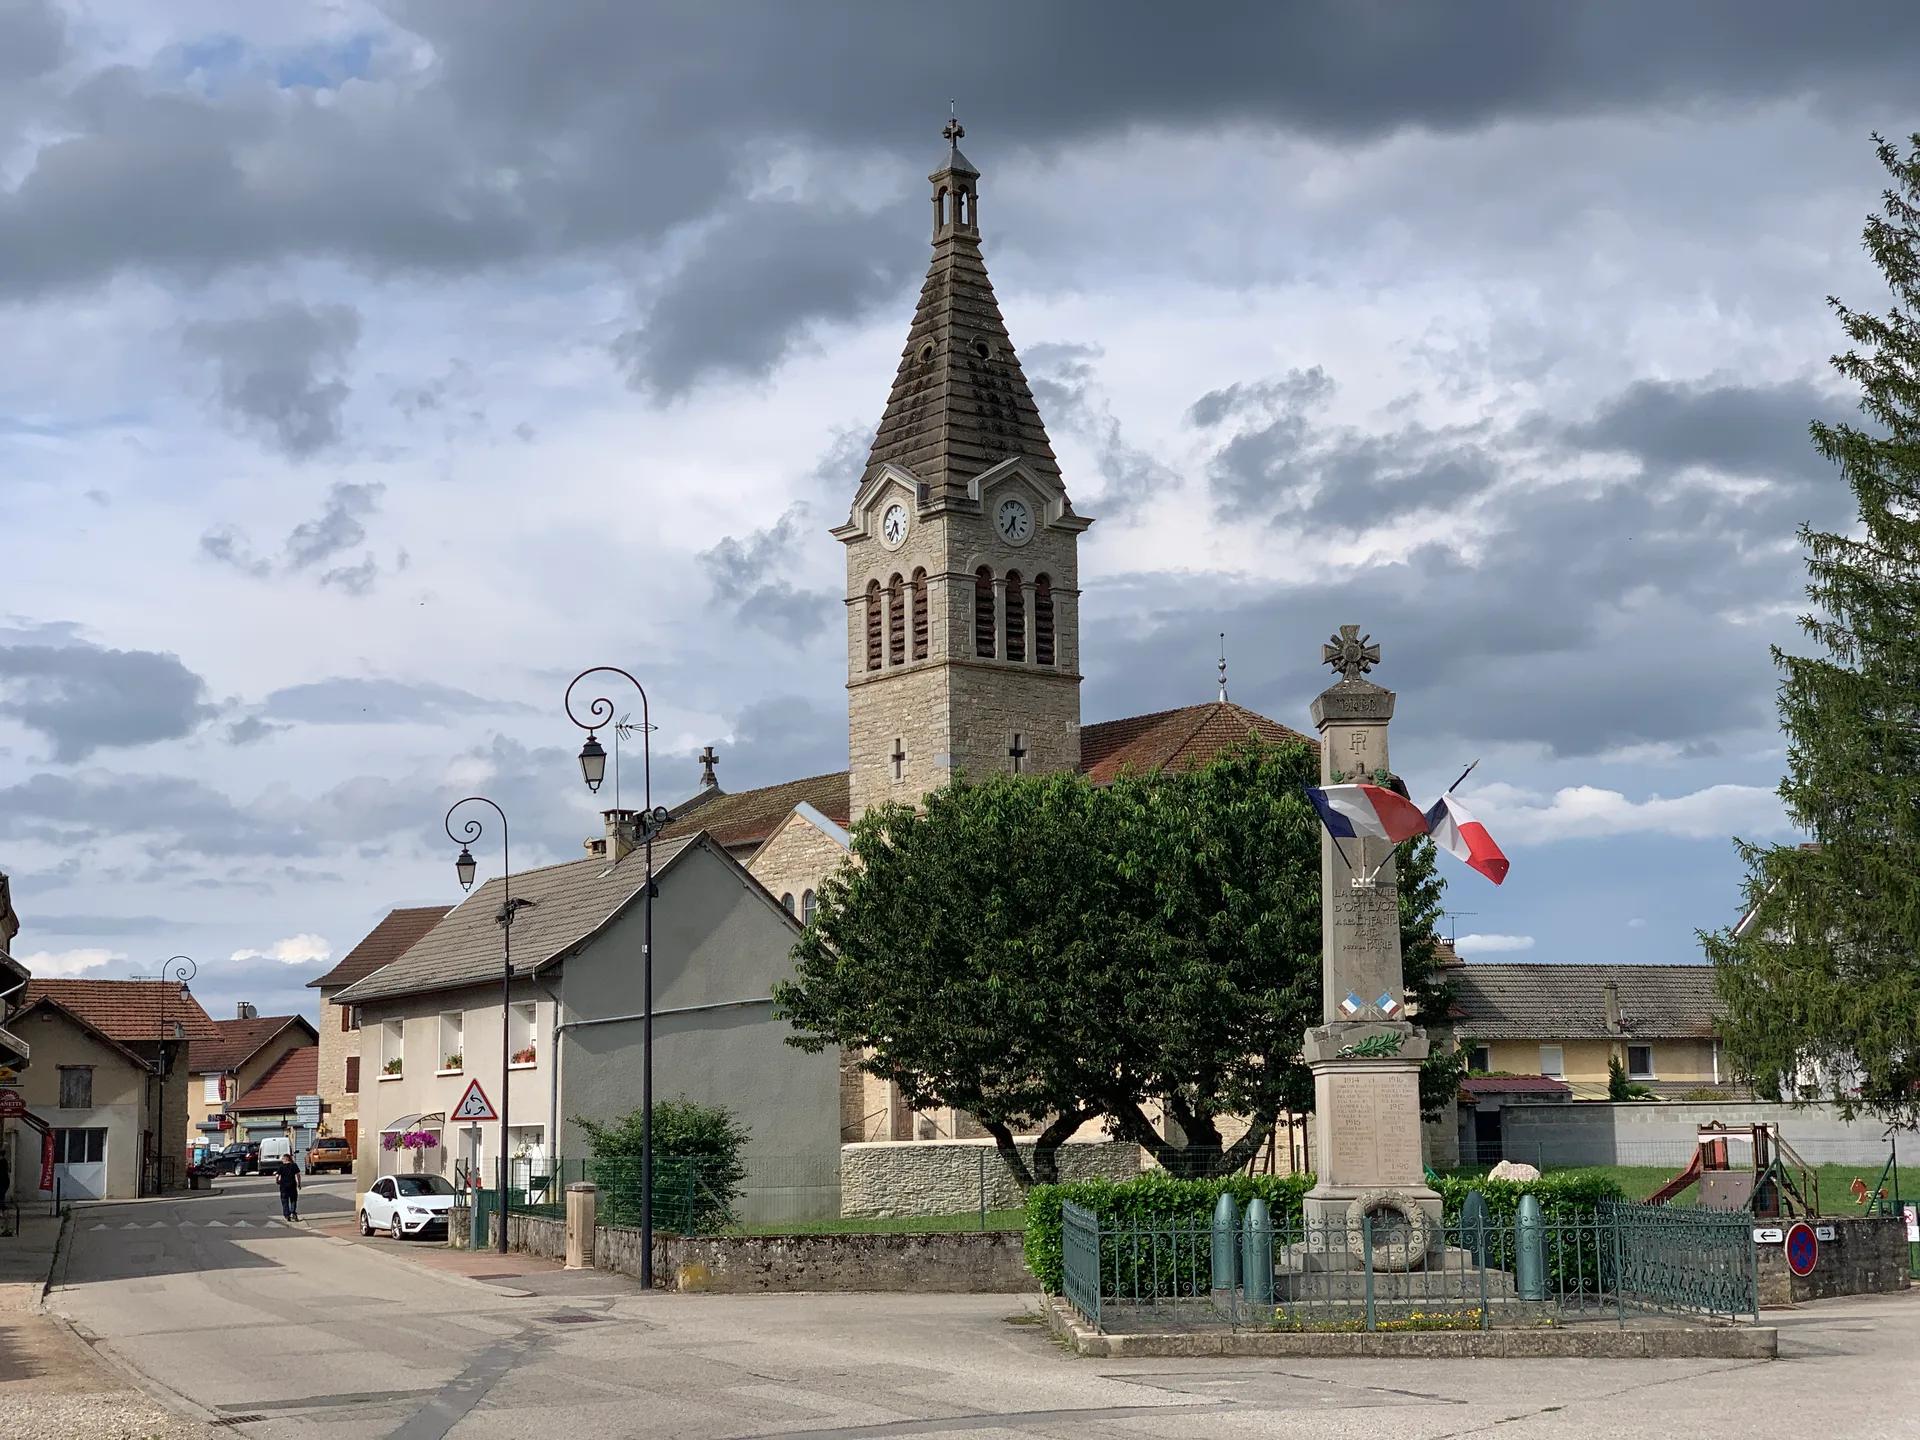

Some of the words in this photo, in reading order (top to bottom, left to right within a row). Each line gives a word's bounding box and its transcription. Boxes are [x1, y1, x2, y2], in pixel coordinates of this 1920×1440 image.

[1334, 889, 1348, 898] LA
[1356, 913, 1398, 927] ENFANTS
[1344, 1076, 1360, 1084] 1914
[1391, 1125, 1406, 1133] 1918
